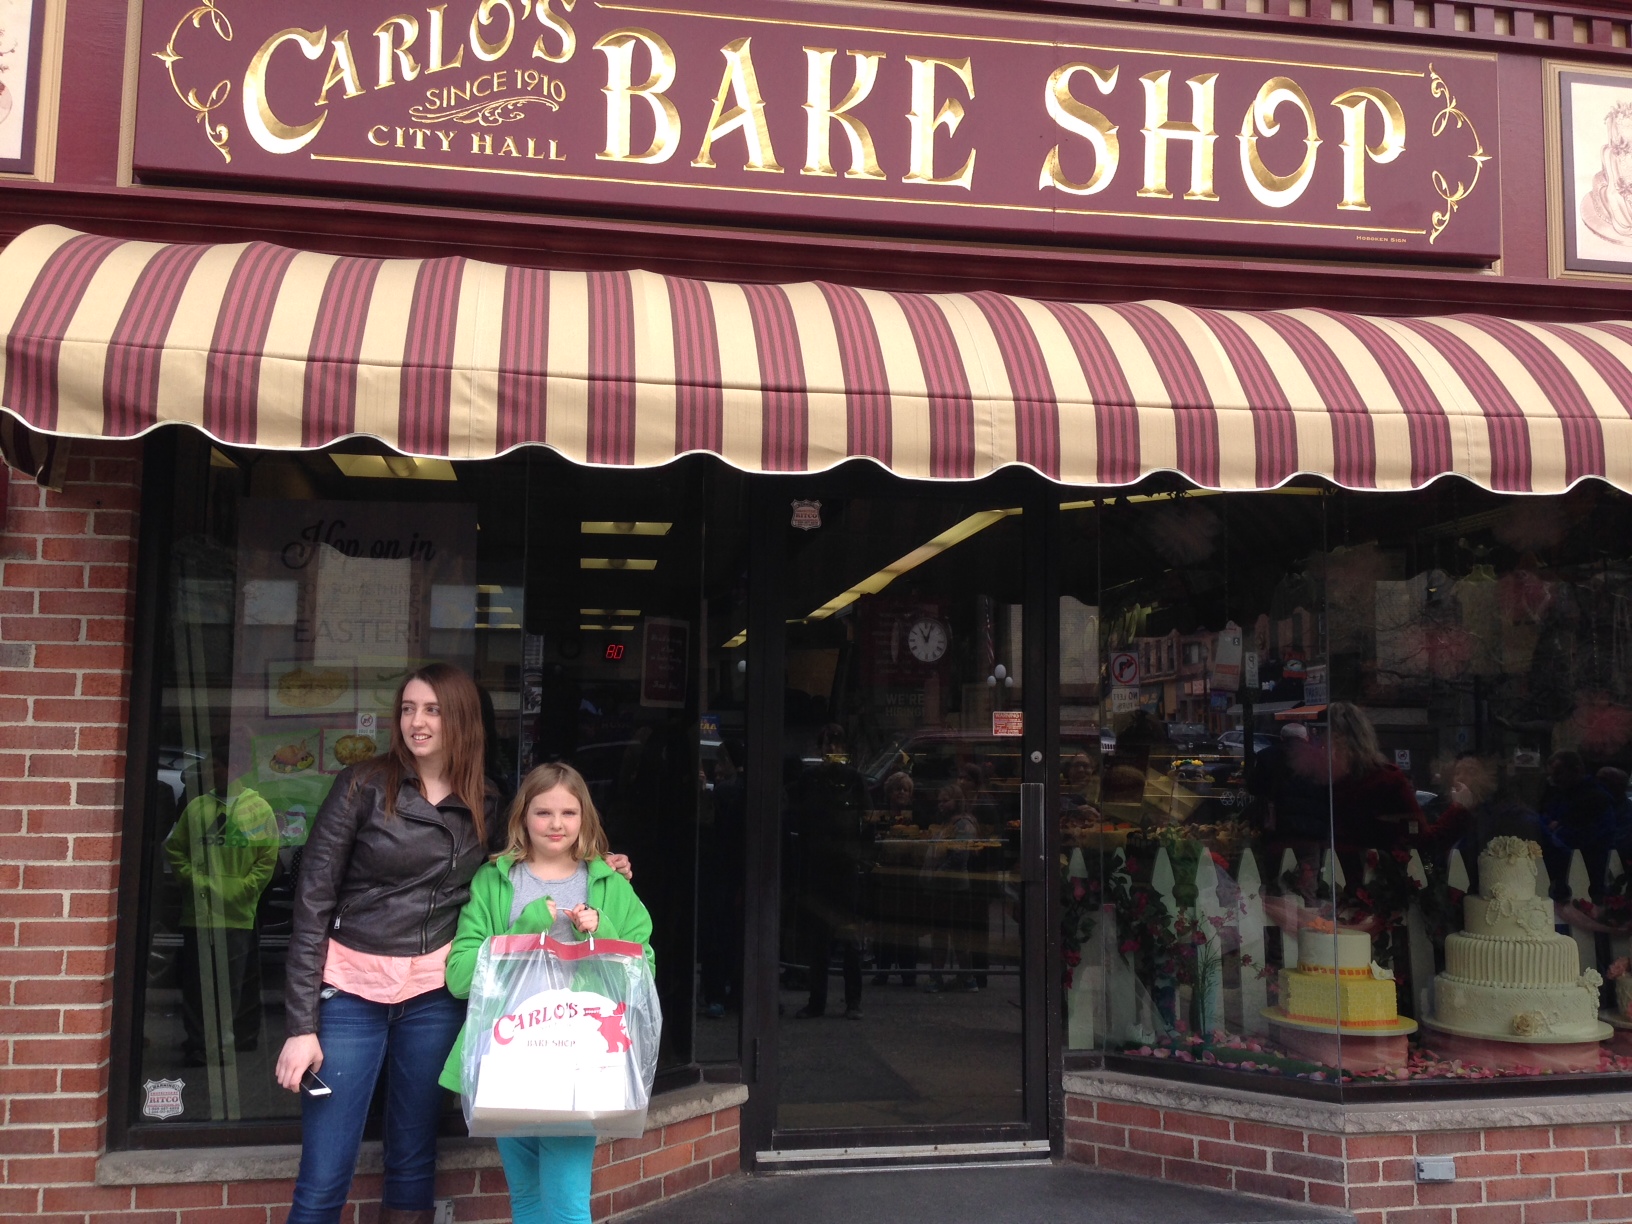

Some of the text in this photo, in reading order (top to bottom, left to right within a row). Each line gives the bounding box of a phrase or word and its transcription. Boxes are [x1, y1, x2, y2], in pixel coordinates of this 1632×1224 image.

[243, 0, 577, 155] CARLO'S
[425, 68, 567, 109] SINCE 1910
[592, 26, 1407, 212] BAKE SHOP
[367, 124, 567, 161] CITY HALL
[409, 532, 436, 562] in
[294, 619, 420, 643] EASTER!
[606, 644, 624, 659] 80
[493, 1002, 578, 1046] CARLO'S
[149, 1096, 178, 1104] RITCO
